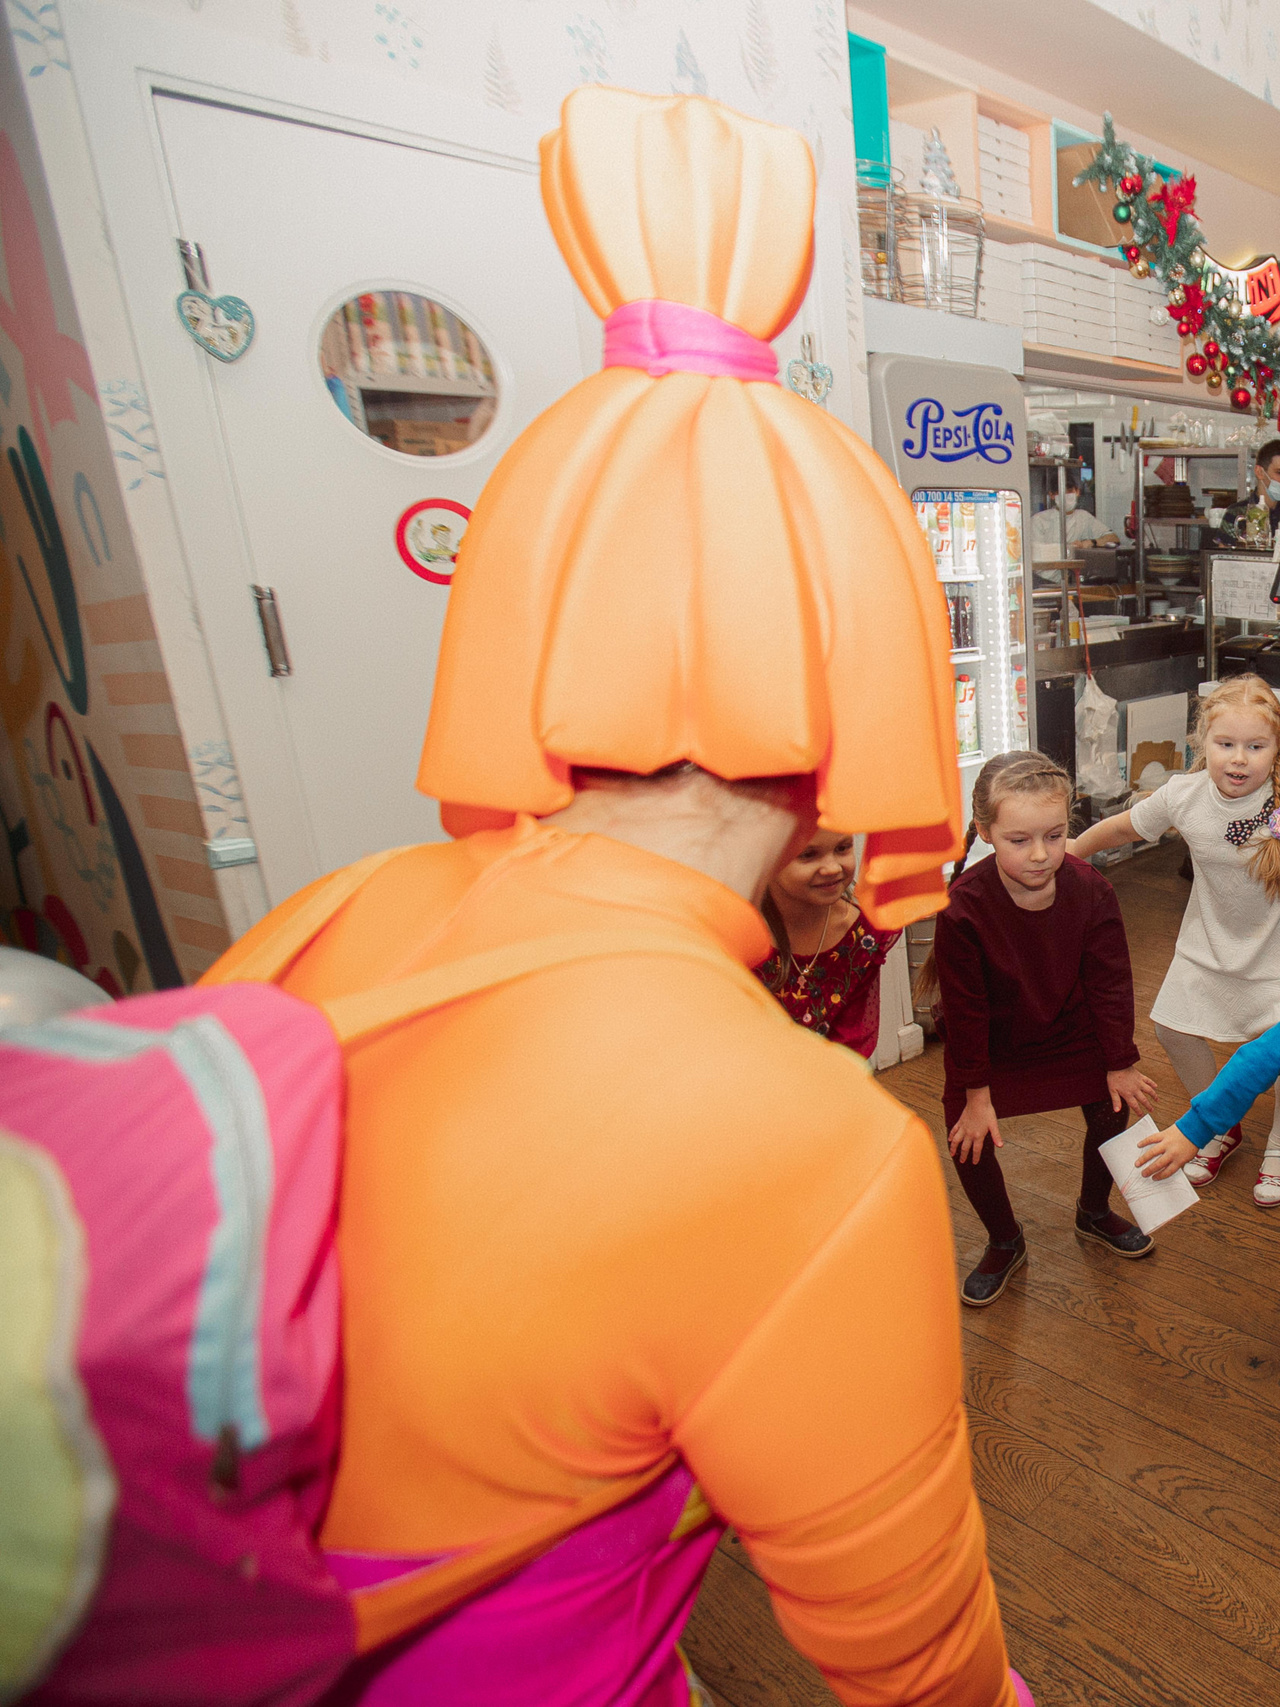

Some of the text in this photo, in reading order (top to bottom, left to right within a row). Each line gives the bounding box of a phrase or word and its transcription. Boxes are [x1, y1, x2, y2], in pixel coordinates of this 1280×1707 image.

[926, 491, 942, 502] 700
[943, 491, 953, 502] 14
[954, 491, 964, 502] 55
[936, 539, 951, 553] J7
[958, 687, 975, 703] J7
